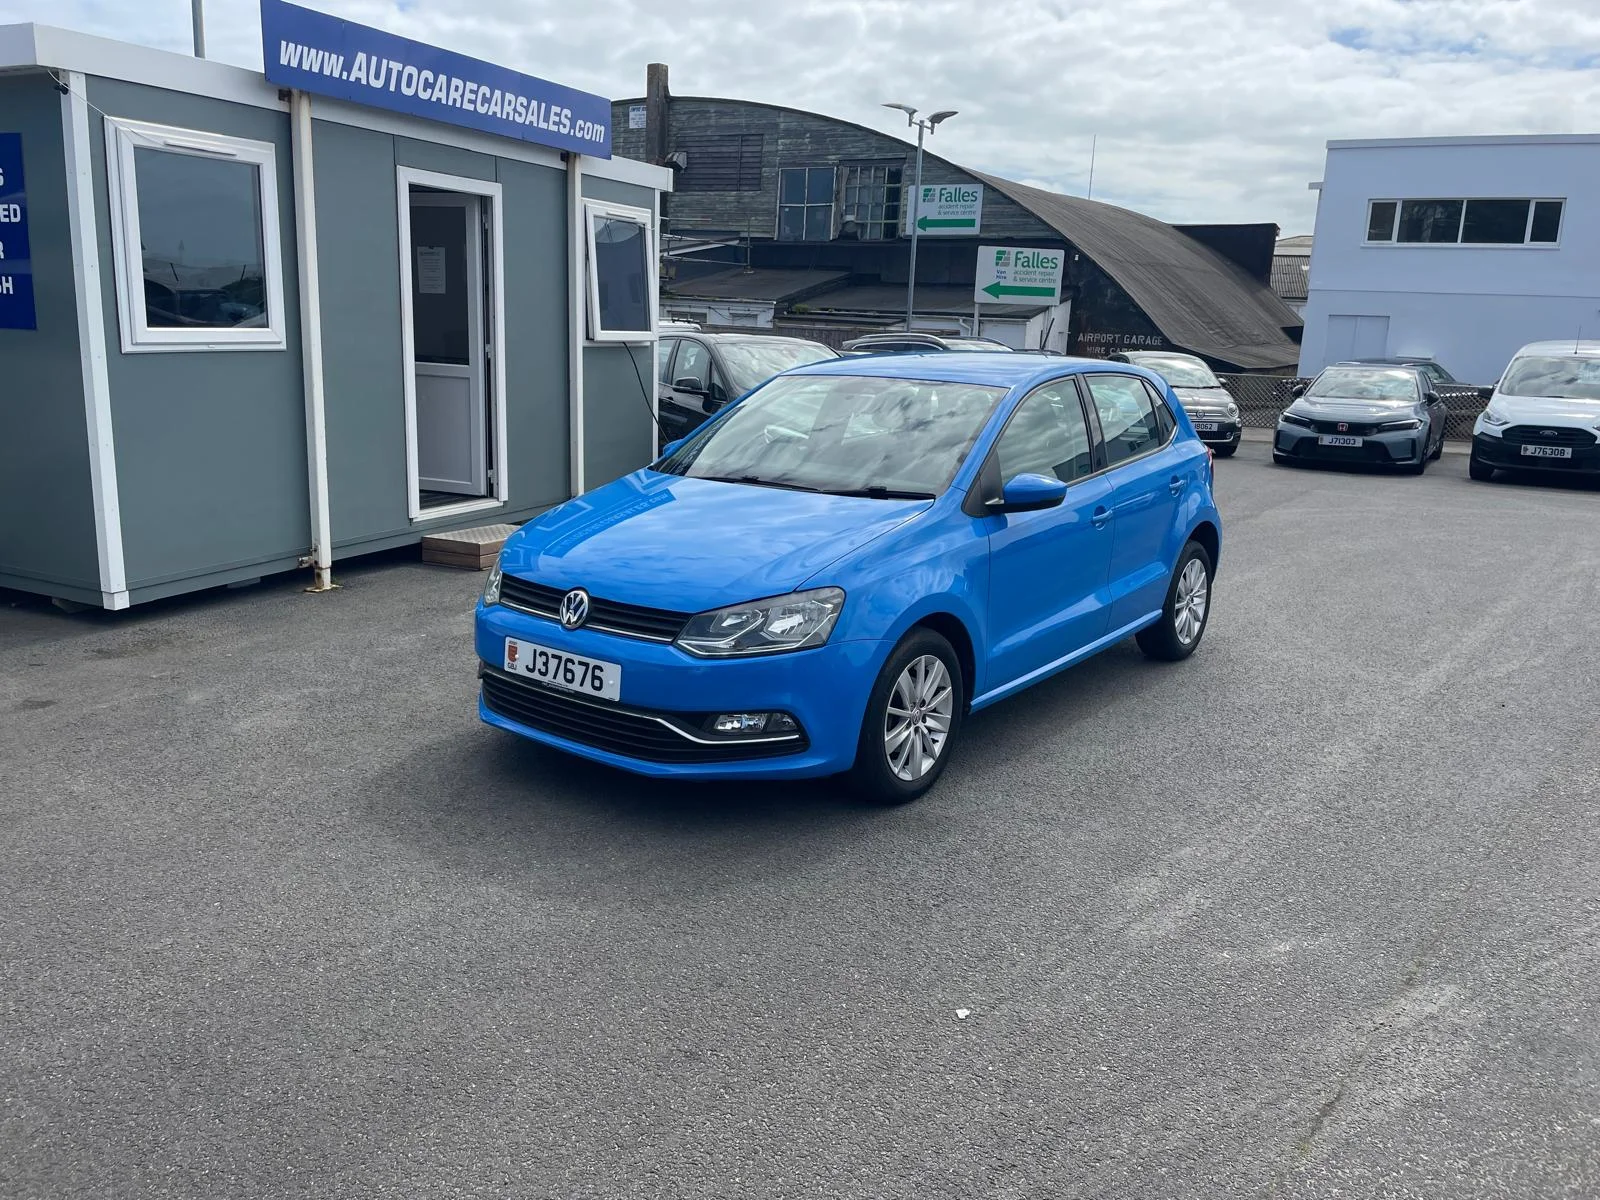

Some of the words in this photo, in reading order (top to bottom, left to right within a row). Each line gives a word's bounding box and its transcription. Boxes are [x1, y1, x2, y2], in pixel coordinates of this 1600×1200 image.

[939, 187, 978, 203] Falles
[1014, 251, 1058, 269] Falles
[1077, 333, 1121, 344] AIRPORT
[1124, 334, 1162, 346] GARAGE
[1086, 346, 1106, 354] HIRE
[1530, 446, 1566, 457] J76308
[525, 648, 604, 692] J37676
